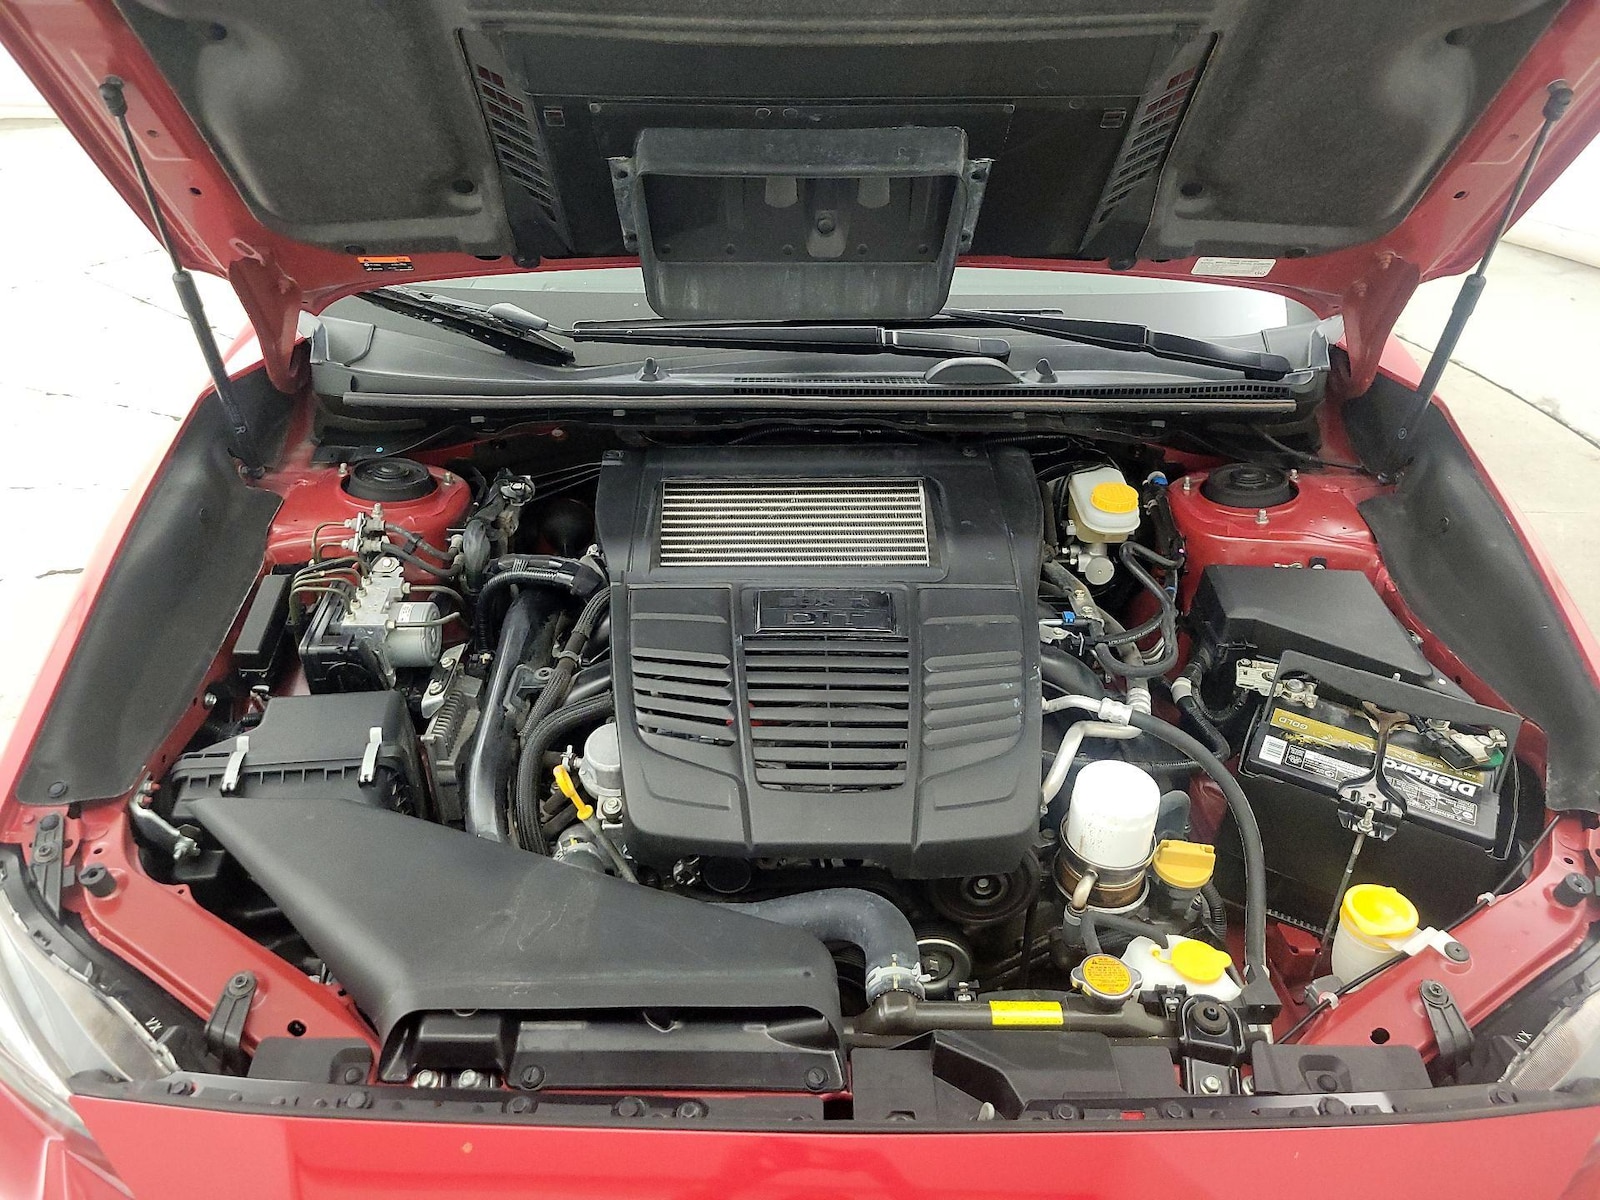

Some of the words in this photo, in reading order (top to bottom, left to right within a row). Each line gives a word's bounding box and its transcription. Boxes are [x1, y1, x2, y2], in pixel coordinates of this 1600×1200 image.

[784, 611, 866, 625] DIT
[1278, 716, 1309, 730] GOLD
[1383, 757, 1477, 797] DieHard
[145, 1016, 163, 1033] VX
[1515, 1030, 1533, 1043] VX
